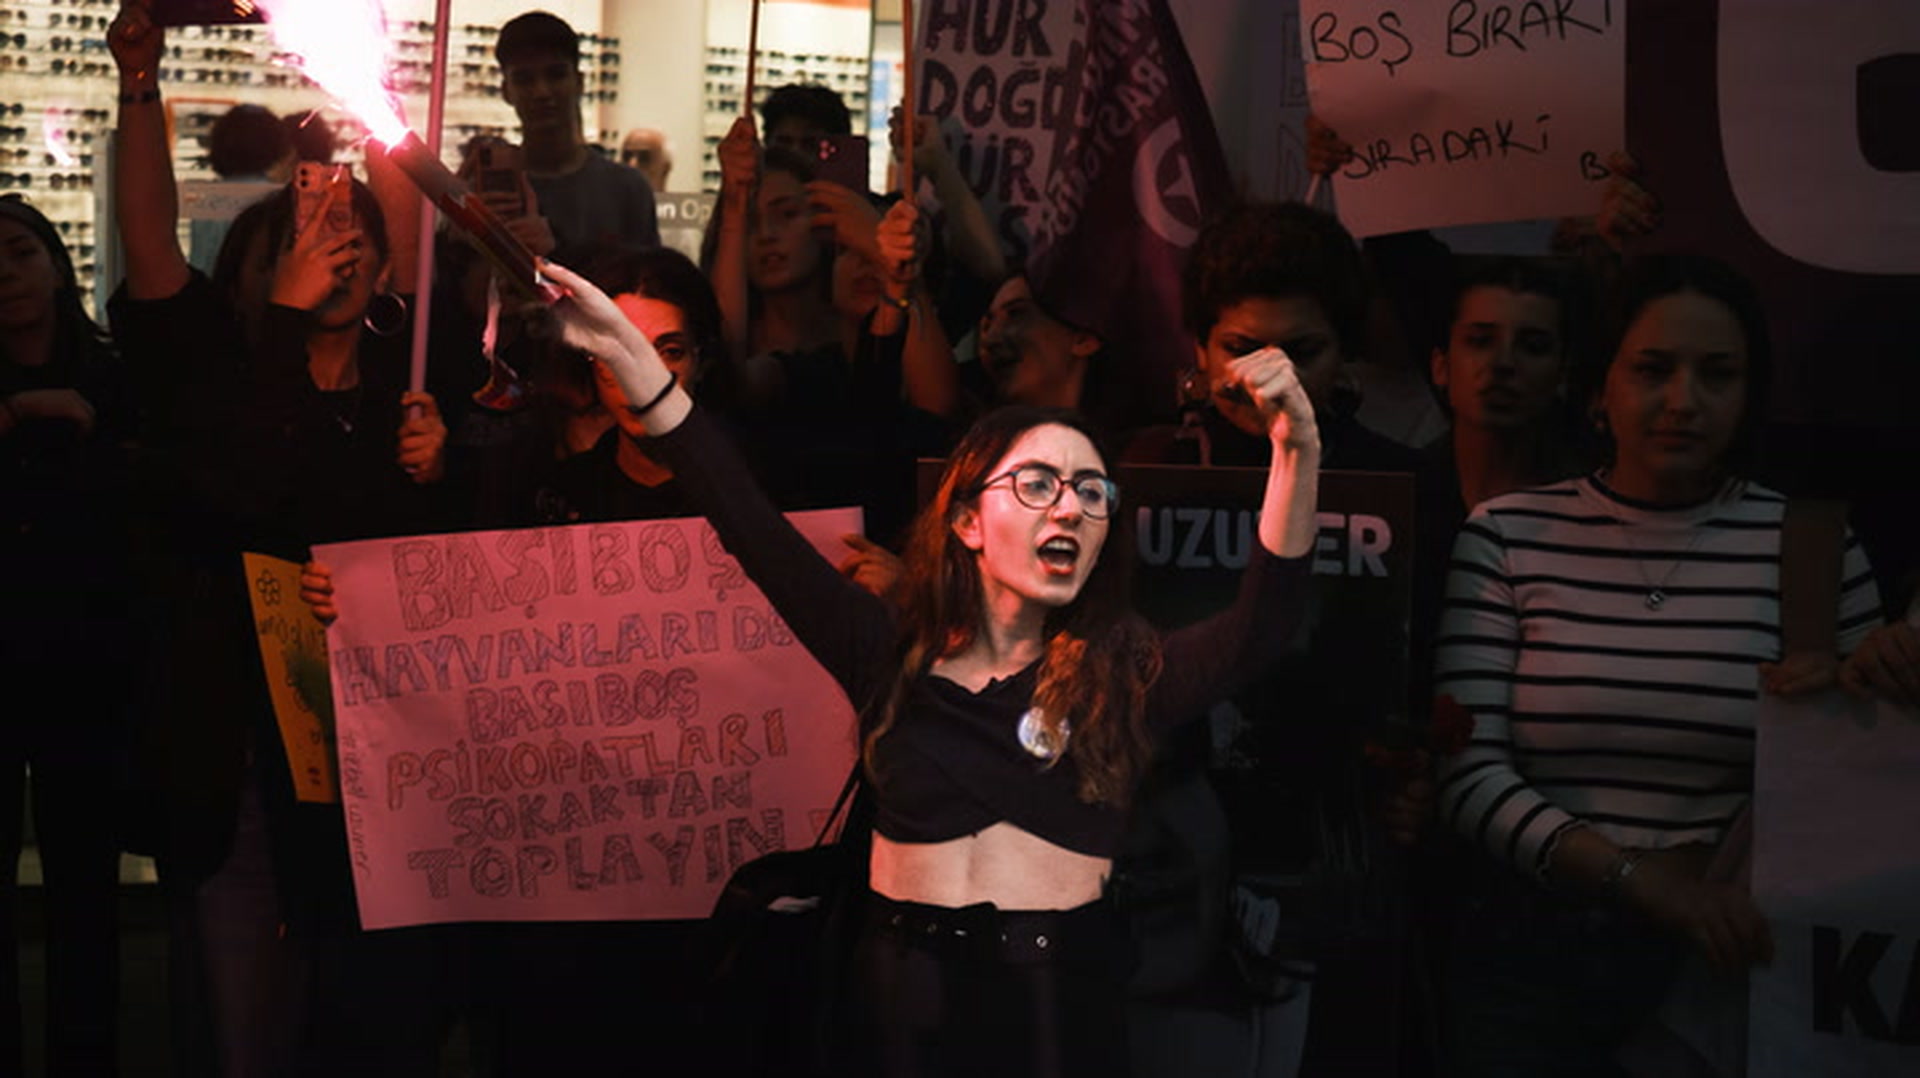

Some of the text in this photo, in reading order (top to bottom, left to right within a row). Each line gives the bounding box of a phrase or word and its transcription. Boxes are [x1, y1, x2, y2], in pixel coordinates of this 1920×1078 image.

[1310, 12, 1412, 76] BOŞ
[1135, 505, 1394, 578] UZUER
[335, 610, 720, 706] HAYVANLARI
[386, 707, 788, 811] PSİKOPATLARI
[449, 770, 753, 848] SOKAKTAN
[407, 807, 786, 898] TOPLAYIN
